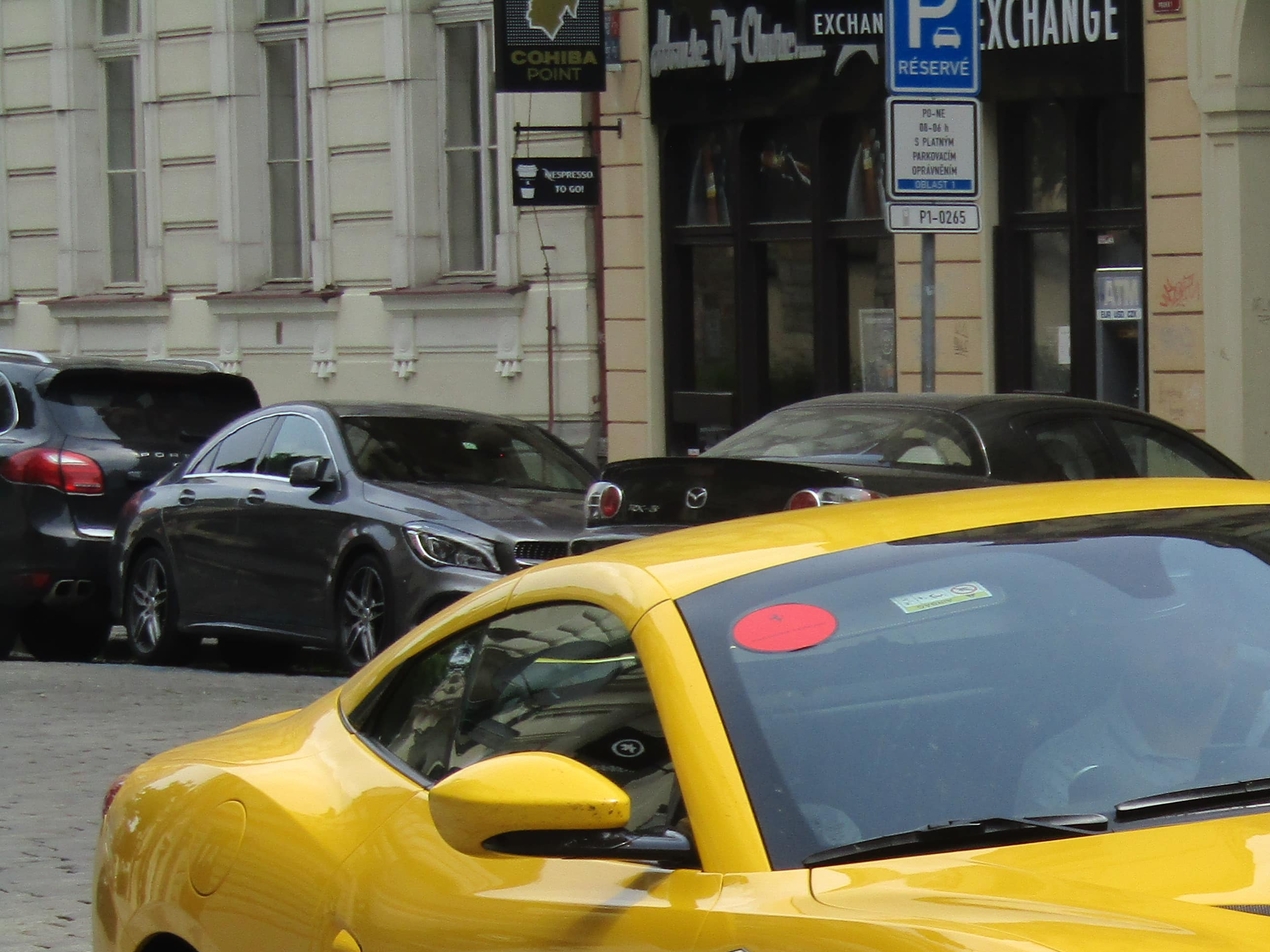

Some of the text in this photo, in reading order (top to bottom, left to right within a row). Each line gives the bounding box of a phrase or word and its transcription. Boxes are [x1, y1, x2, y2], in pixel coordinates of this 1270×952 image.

[510, 50, 598, 66] COHIBA
[898, 56, 970, 76] RÉSERVÉ
[527, 68, 582, 81] POINT
[914, 135, 955, 147] S PLATNÝM
[912, 150, 957, 161] PARKOVACÍM
[911, 164, 958, 176] OPRÁVNĚNÍM
[554, 185, 585, 194] TO GO!
[914, 180, 956, 189] OBLAST 1
[919, 210, 966, 225] P1-0265
